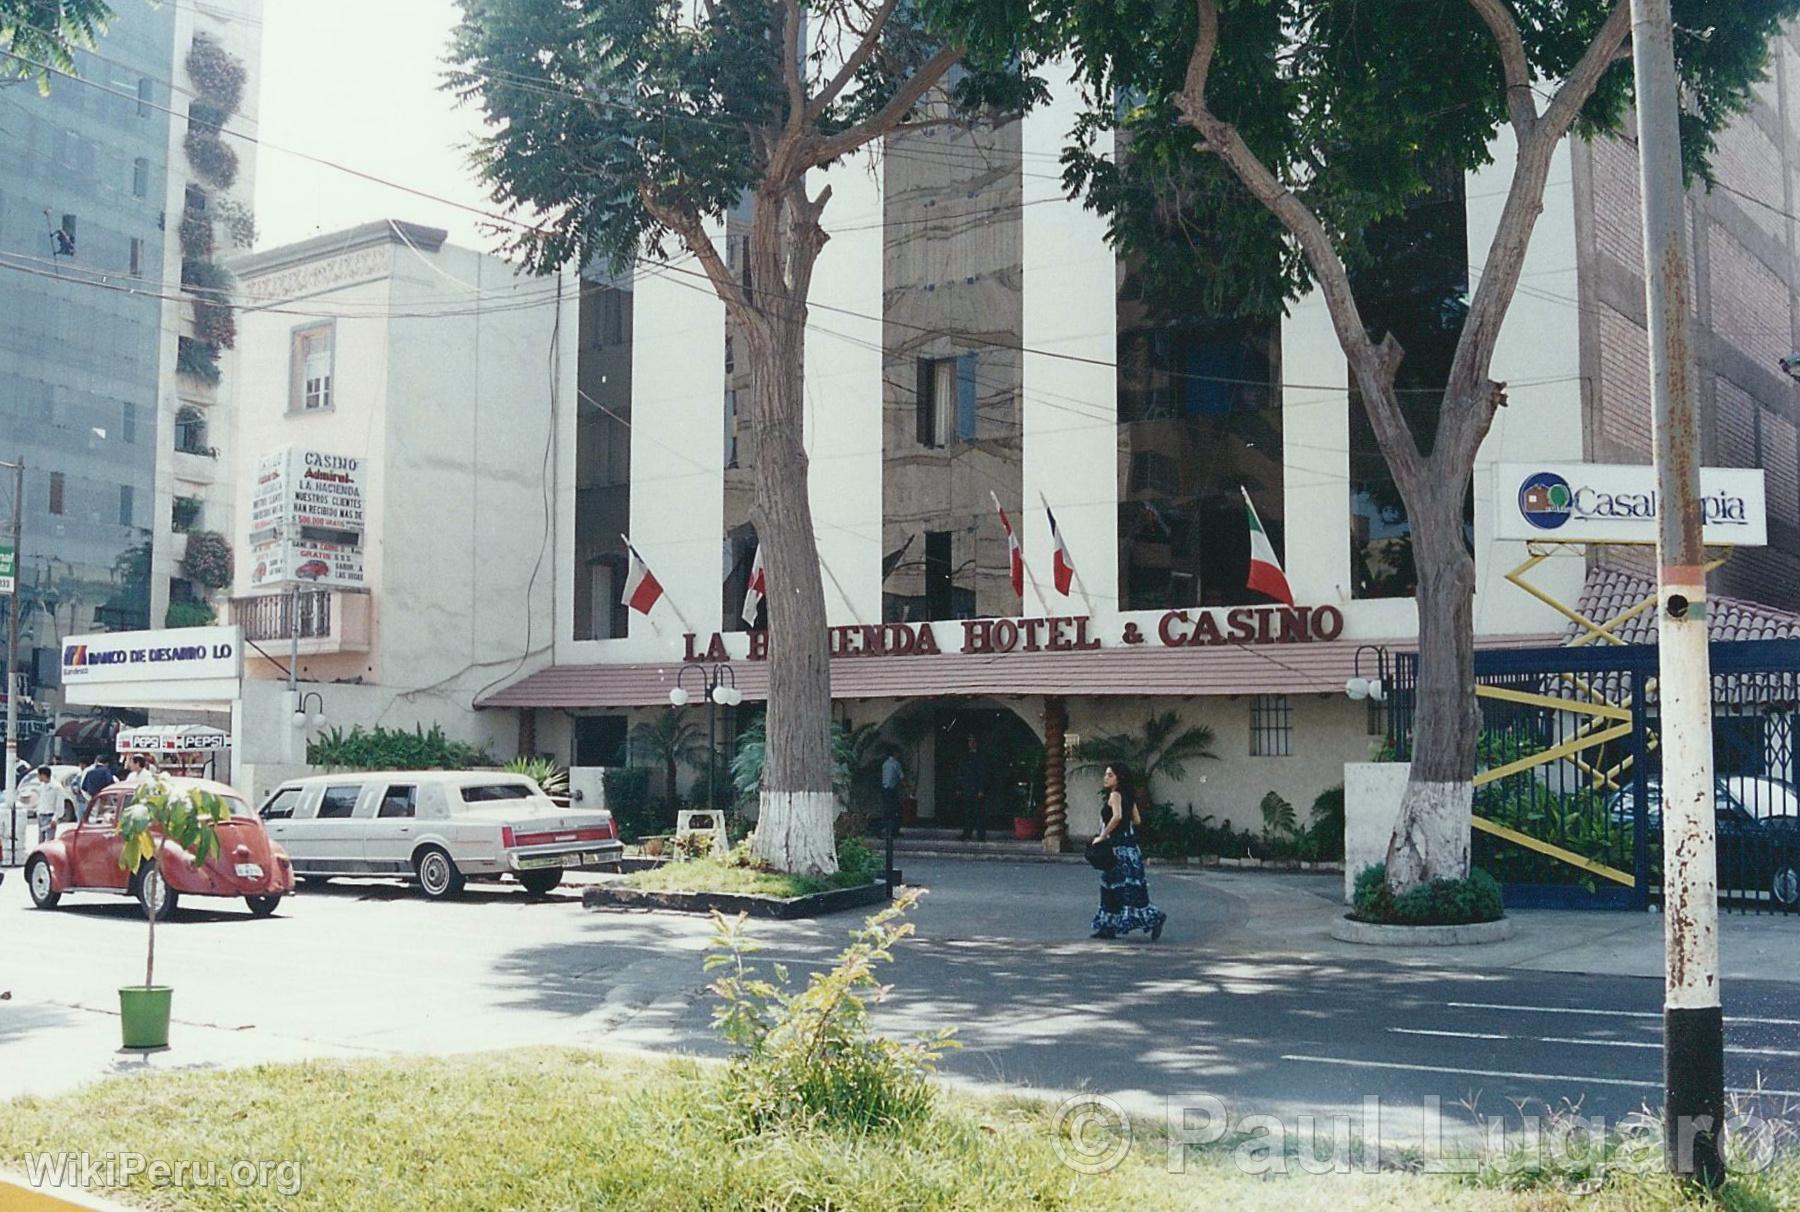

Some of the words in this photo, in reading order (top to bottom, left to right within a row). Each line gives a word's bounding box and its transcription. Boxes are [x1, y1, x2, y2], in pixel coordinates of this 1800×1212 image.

[305, 452, 357, 471] CASINO
[316, 482, 360, 497] HACIENDA
[295, 492, 328, 504] NUESTROS
[332, 496, 361, 509] CLIENTES
[1574, 486, 1745, 526] Casalpia
[293, 503, 307, 513] HAN
[308, 505, 338, 517] RECIBIDO
[339, 509, 353, 518] MAS
[355, 511, 362, 520] DE
[683, 632, 730, 662] LA
[961, 616, 1100, 653] HOTEL
[1121, 622, 1144, 644] &
[1158, 603, 1342, 647] CASINO
[88, 649, 127, 665] BANCO
[130, 649, 146, 663] DE
[212, 643, 232, 659] LO
[134, 736, 158, 746] PEPSI
[185, 736, 223, 748] PEPSI
